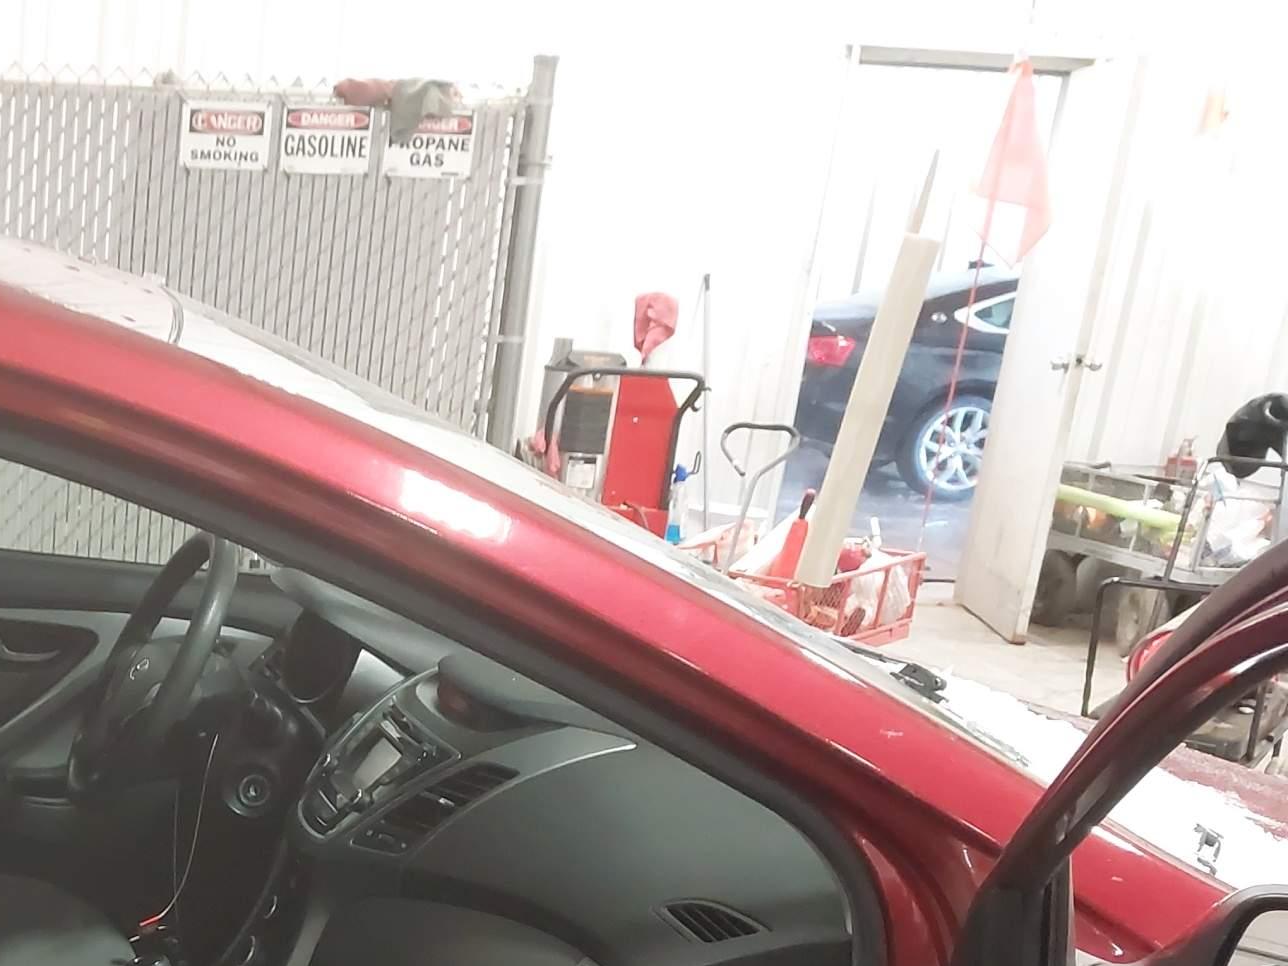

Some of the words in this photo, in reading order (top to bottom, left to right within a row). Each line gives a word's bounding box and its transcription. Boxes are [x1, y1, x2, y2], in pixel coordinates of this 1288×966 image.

[301, 111, 355, 128] DANGER
[216, 135, 236, 148] NO
[284, 134, 368, 158] GASOLINE
[191, 149, 259, 162] SMOKING
[410, 153, 444, 167] GAS
